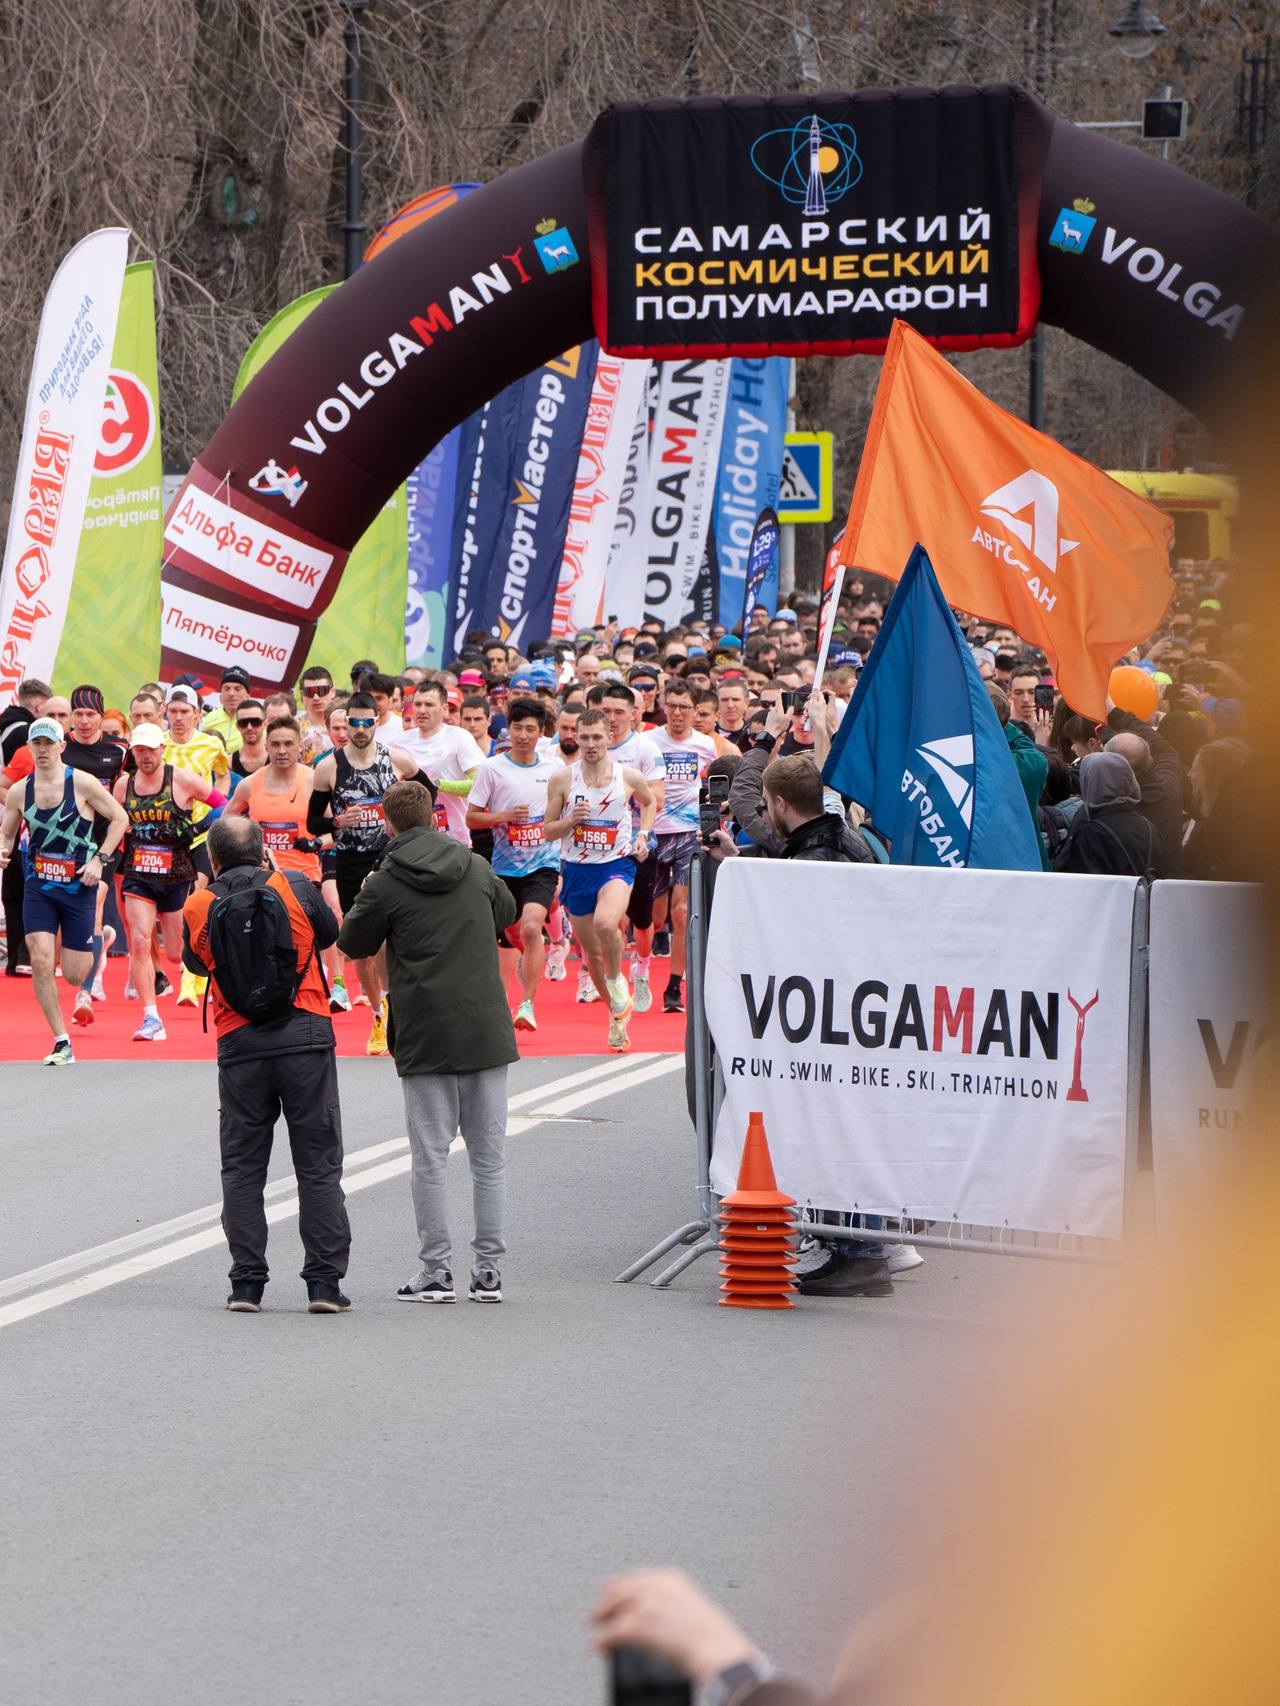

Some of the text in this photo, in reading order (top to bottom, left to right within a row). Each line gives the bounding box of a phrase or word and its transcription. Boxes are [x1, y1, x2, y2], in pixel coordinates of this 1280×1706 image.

[634, 207, 992, 254] САМАРСКИЙ
[635, 243, 990, 288] КОСМИЧЕСКИЙ
[74, 294, 94, 330] ВДА
[635, 283, 988, 321] ПОЛУМАРАФОН
[290, 263, 512, 454] VOLGAMAN
[720, 408, 770, 579] Holiday
[689, 503, 702, 540] BIKE
[177, 498, 322, 588] Альфа Банк
[166, 607, 287, 662] Пятёрочка
[667, 763, 691, 774] 2035
[360, 809, 380, 821] 014
[515, 828, 542, 840] 1300
[900, 769, 965, 868] ВТОБАН
[266, 833, 290, 844] 1822
[582, 830, 608, 844] 1566
[42, 862, 67, 876] 1604
[141, 855, 163, 867] 1204
[740, 973, 1059, 1060] VOLGAMAN
[730, 1056, 1059, 1100] RUN SWIM BIKE SKI TRIATHLON
